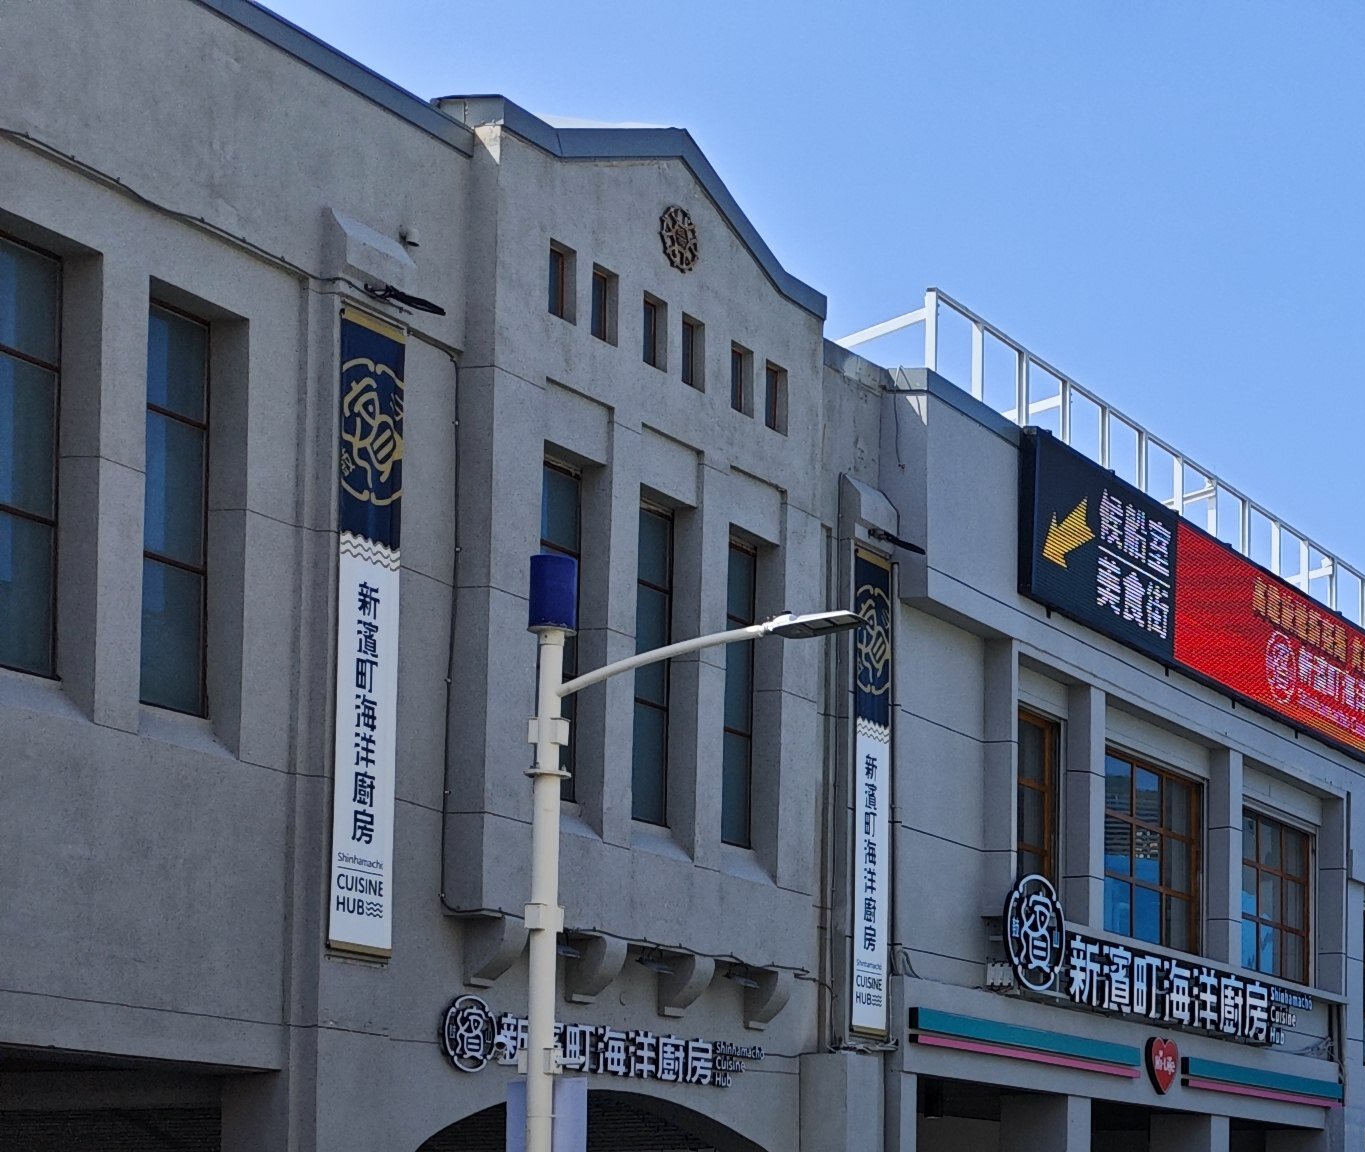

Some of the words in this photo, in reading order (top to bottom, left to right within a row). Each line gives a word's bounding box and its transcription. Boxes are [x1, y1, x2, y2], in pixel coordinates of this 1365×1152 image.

[1100, 488, 1171, 576] 候船室
[1097, 557, 1169, 639] 美食街
[351, 580, 380, 845] 新濱町海洋廚房
[864, 753, 877, 952] 新濱町海洋廚房
[337, 873, 383, 898] CUISINE
[336, 894, 365, 916] HUB
[856, 974, 882, 991] CUISINE
[1070, 935, 1268, 1041] 新濱町海洋廚房
[856, 991, 871, 1006] HUB
[1271, 1007, 1297, 1028] Cuisine
[1271, 1027, 1286, 1045] Hub
[500, 1012, 713, 1086] 新町海洋廚房
[716, 1055, 746, 1073] Cuisine
[715, 1073, 732, 1088] Hub
